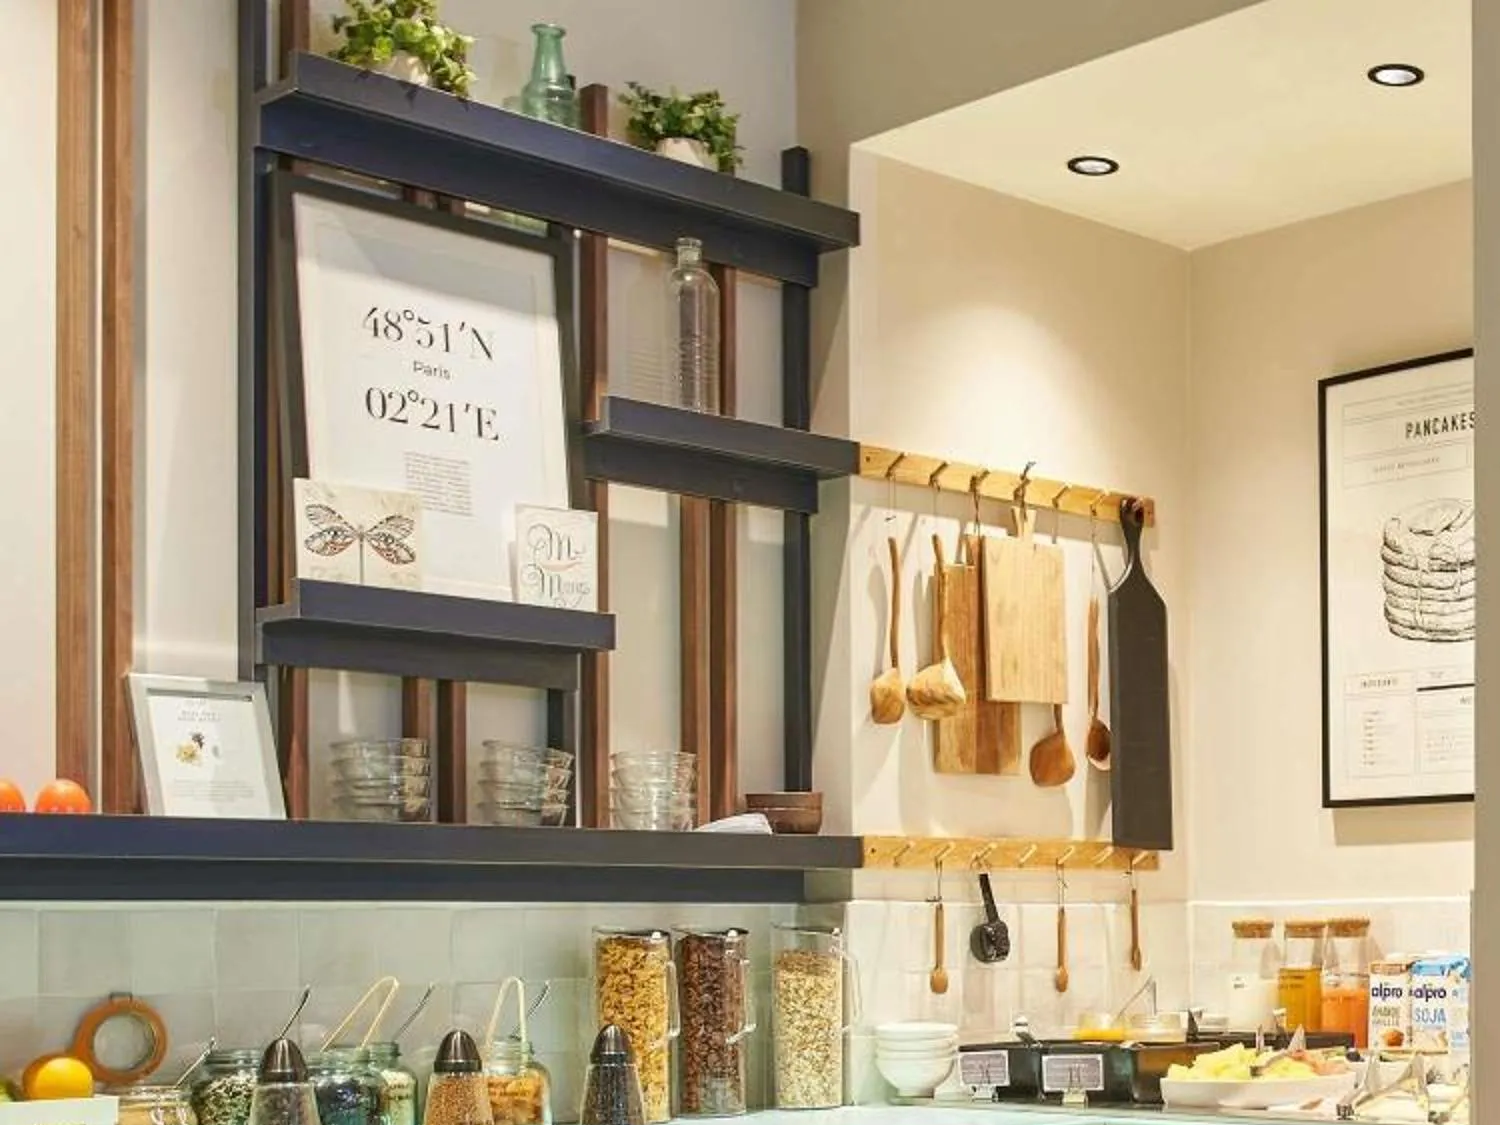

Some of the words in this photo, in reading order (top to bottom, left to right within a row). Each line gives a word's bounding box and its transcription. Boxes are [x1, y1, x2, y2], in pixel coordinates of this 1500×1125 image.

[413, 360, 451, 380] Paris
[1404, 410, 1475, 440] PANCAKES
[1371, 983, 1403, 1000] alpro
[1413, 984, 1447, 1002] alpro
[1414, 1007, 1447, 1023] SOJA
